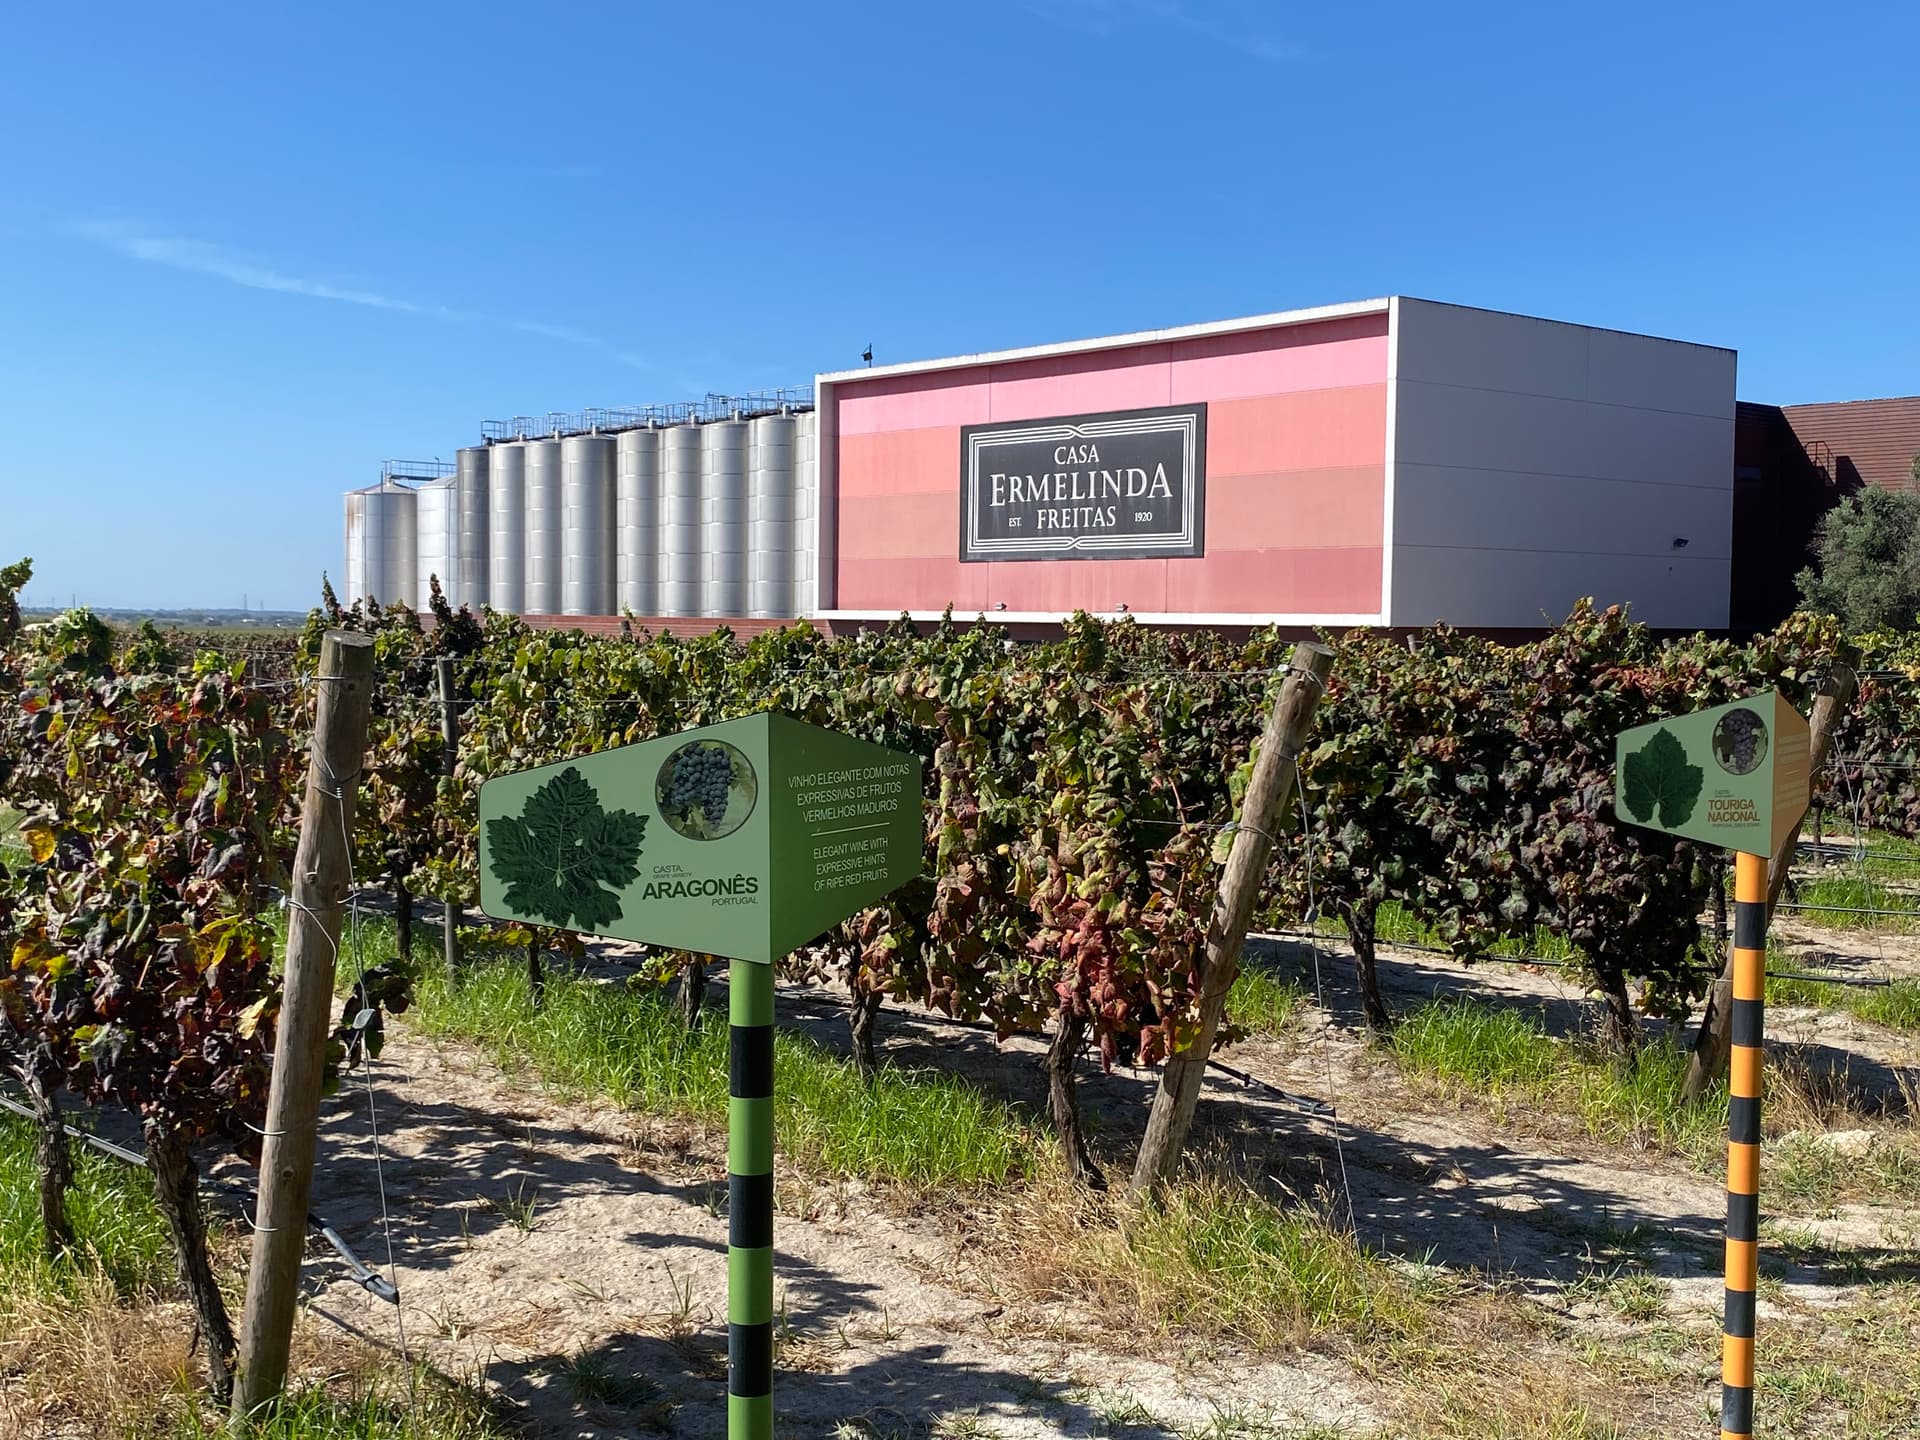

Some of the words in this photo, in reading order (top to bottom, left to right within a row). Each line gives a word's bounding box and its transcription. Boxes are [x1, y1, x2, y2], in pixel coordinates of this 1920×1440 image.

[1054, 444, 1100, 465] CASA
[989, 462, 1173, 507] ERMELINDA
[1037, 505, 1116, 529] FREITAS
[1134, 511, 1153, 522] 1920
[788, 774, 816, 788] VINHO
[817, 769, 862, 785] ELEGANTE
[863, 767, 882, 780] COM
[883, 763, 910, 777] NOTAS
[797, 787, 856, 806] EXPRESSIVAS
[856, 785, 868, 798] DE
[869, 781, 902, 796] FRUTOS
[1708, 799, 1755, 811] TOURIGA
[802, 804, 856, 823] VERMELHOS
[856, 799, 898, 815] MADUROS
[1708, 811, 1761, 823] NACIONAL
[813, 843, 849, 859] ELEGANT
[849, 840, 869, 853] WINE
[870, 837, 889, 849] WITH
[816, 857, 863, 875] EXPRESSIVE
[863, 853, 886, 866] HINTS
[642, 873, 759, 900] ARAGONÊS
[814, 880, 825, 892] OF
[826, 876, 845, 888] RIPE
[845, 873, 861, 885] RED
[862, 868, 888, 881] FRUITS
[711, 897, 759, 906] PORTUGAL
